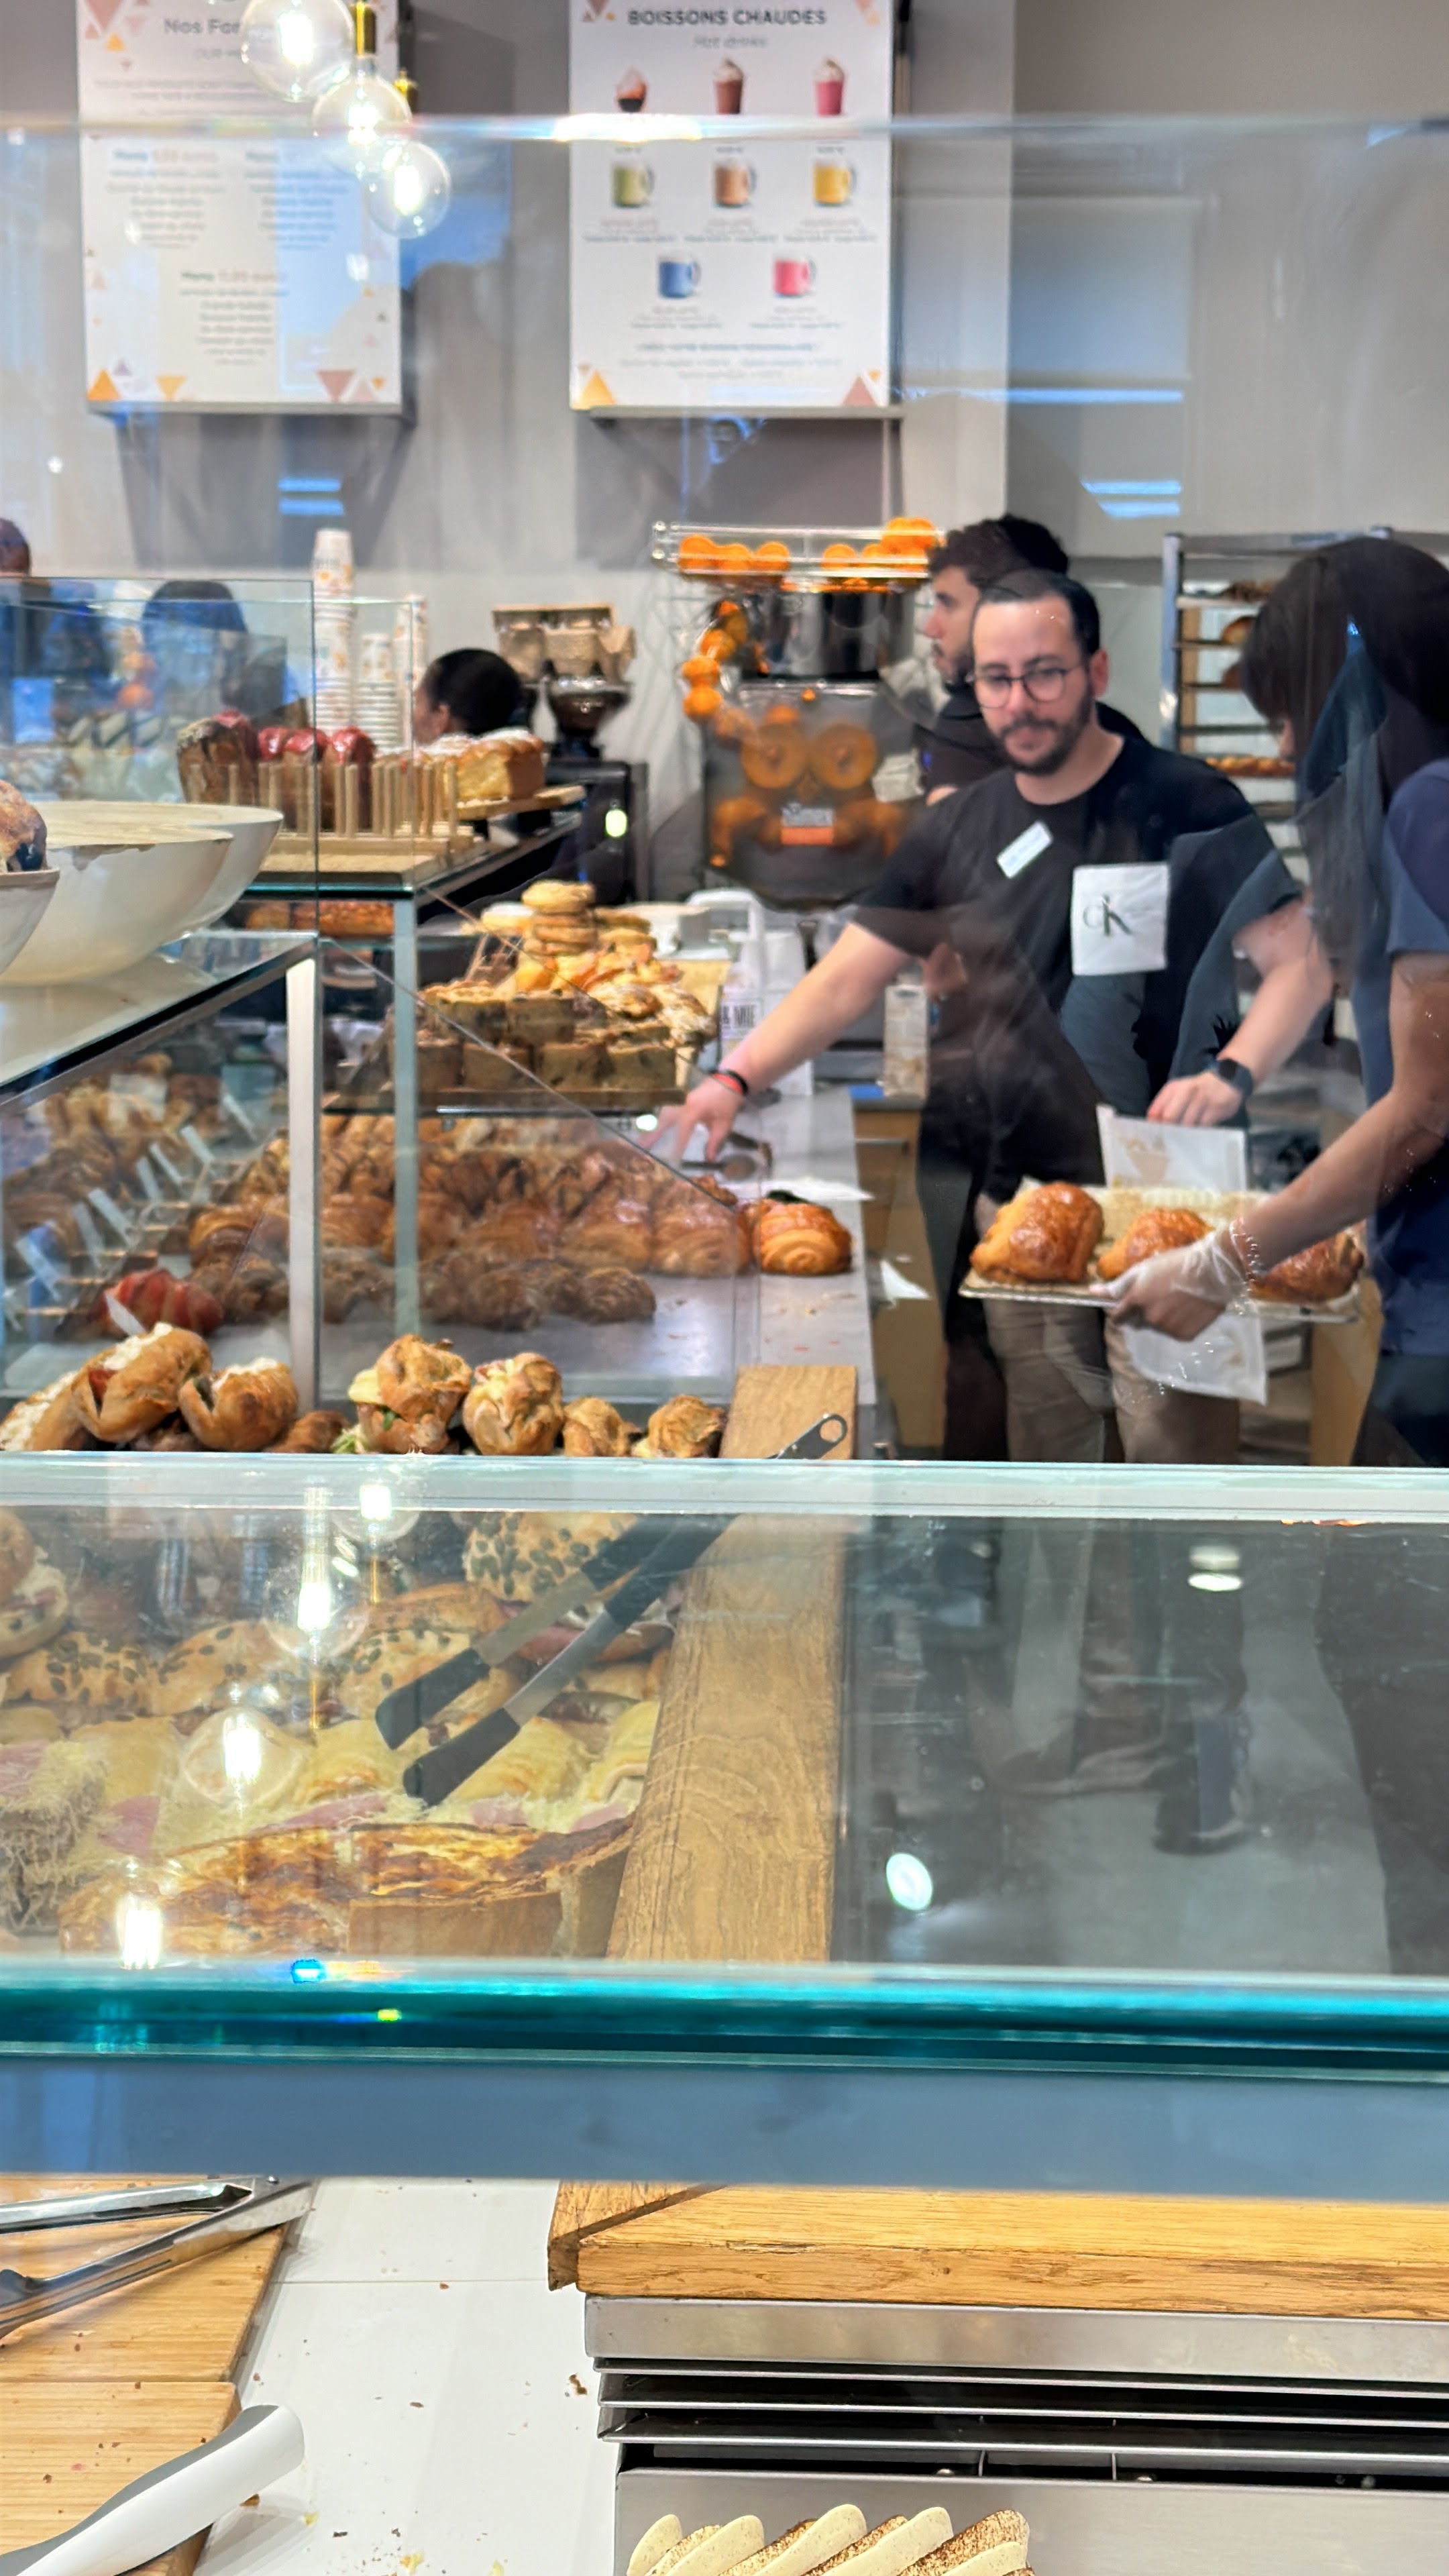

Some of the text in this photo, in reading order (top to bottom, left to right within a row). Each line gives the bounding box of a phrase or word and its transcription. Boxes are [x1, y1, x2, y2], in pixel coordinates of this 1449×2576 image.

[164, 17, 202, 34] Nos
[627, 10, 827, 25] BOISSONS CHAUDES
